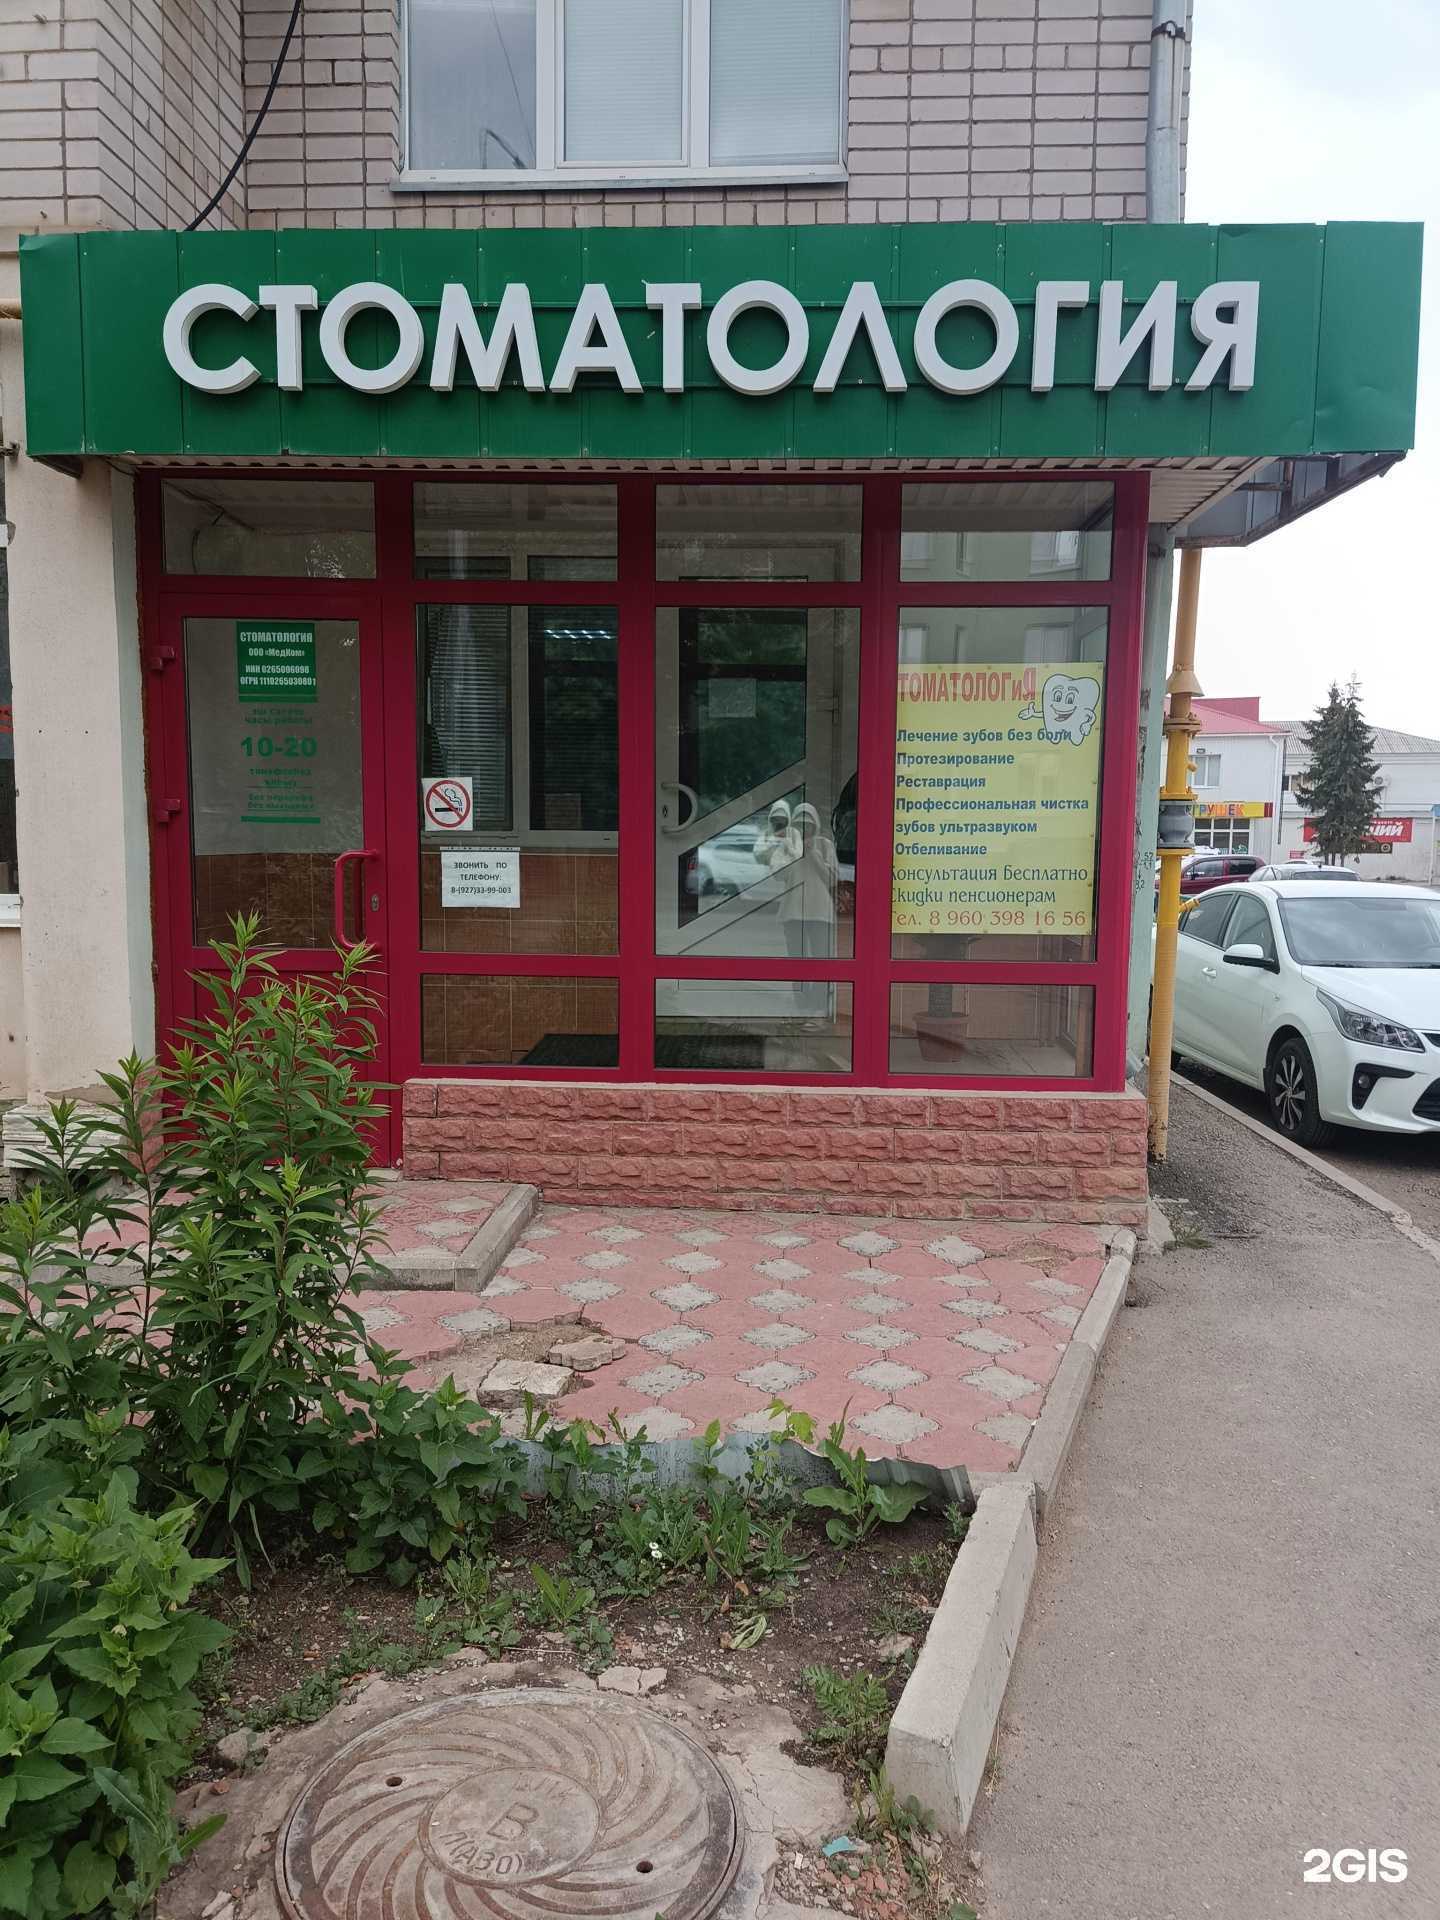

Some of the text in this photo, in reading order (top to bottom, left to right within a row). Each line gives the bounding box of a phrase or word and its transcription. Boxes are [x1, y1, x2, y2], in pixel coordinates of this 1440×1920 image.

[163, 279, 1260, 396] СТОМАТОЛОГИЯ
[240, 631, 313, 643] СТОМАТОЛОГИЯ
[248, 647, 264, 657] ООО
[245, 664, 260, 673] ИНН
[240, 676, 258, 685] ОГРН
[898, 667, 1037, 703] ТОМАТОЛОГиЯ
[897, 728, 1072, 745] Лечение зубов без боли
[240, 736, 318, 757] 10-20
[897, 752, 1015, 768] Протезирование
[896, 775, 986, 790] Реставрация
[896, 797, 1089, 813] Профессиональная чистка
[896, 820, 1038, 836] зубов ультразвуком
[895, 842, 988, 855] Отбеливание
[948, 889, 1056, 907] пенсионерам
[893, 910, 1086, 926] ел. 8 960 398 16 56
